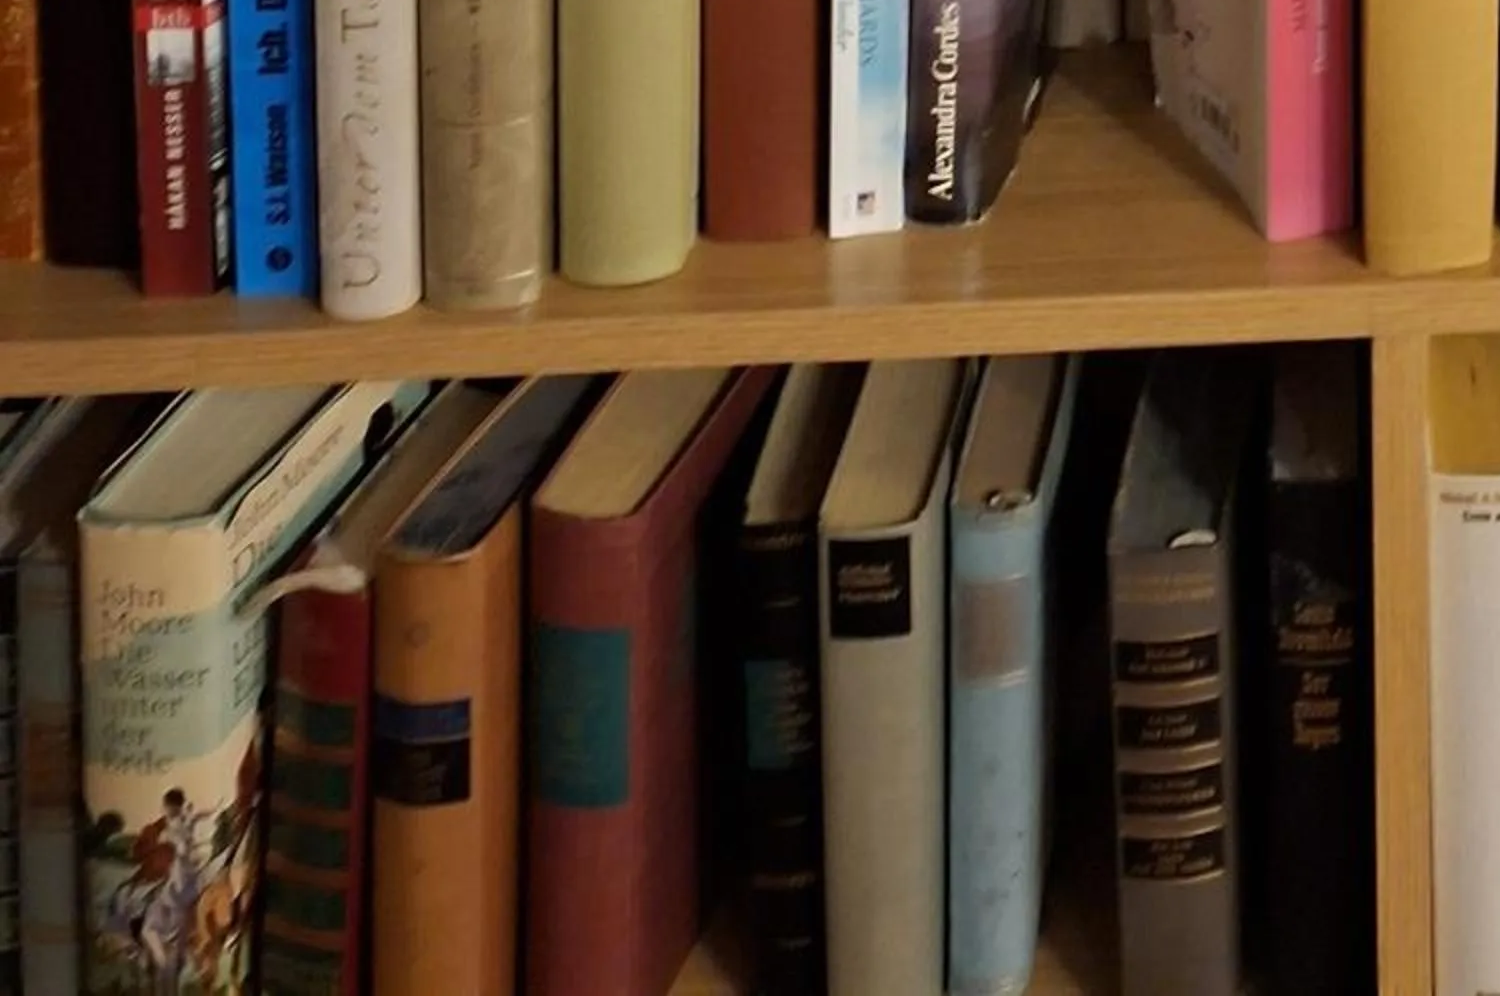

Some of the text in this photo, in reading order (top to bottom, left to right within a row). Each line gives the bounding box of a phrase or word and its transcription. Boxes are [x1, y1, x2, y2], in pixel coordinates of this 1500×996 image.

[930, 2, 961, 83] Cordes
[164, 88, 186, 160] NESSER
[926, 83, 957, 201] Alexandra
[100, 610, 193, 637] Moore
[101, 580, 165, 609] John
